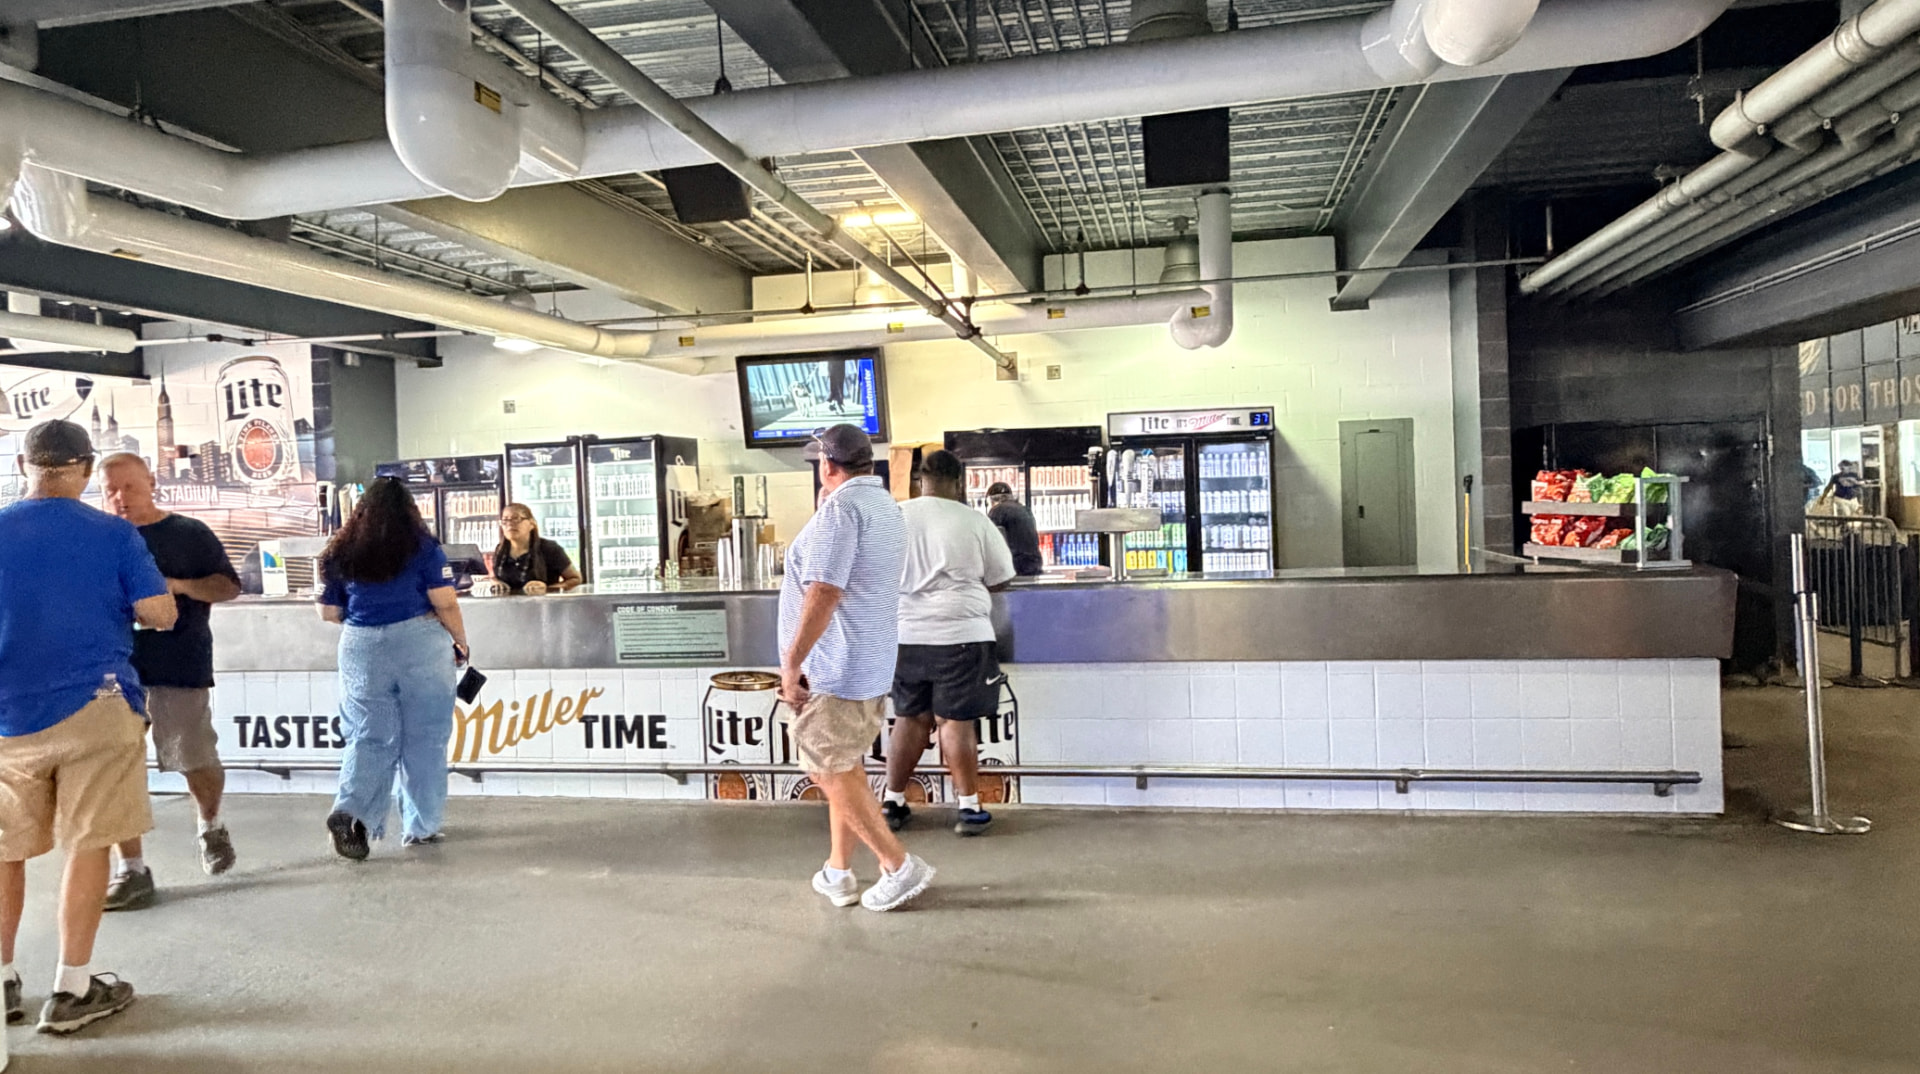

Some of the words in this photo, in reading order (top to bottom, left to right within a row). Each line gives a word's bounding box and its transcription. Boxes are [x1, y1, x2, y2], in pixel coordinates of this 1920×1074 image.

[13, 386, 51, 420] Lite
[222, 378, 283, 422] Lite
[1140, 416, 1170, 434] Lite
[1253, 412, 1269, 425] 37
[160, 485, 219, 503] STADIUM
[233, 715, 346, 749] TASTES
[451, 686, 604, 763] Miller
[578, 715, 667, 749] TIME
[708, 706, 763, 755] Lite
